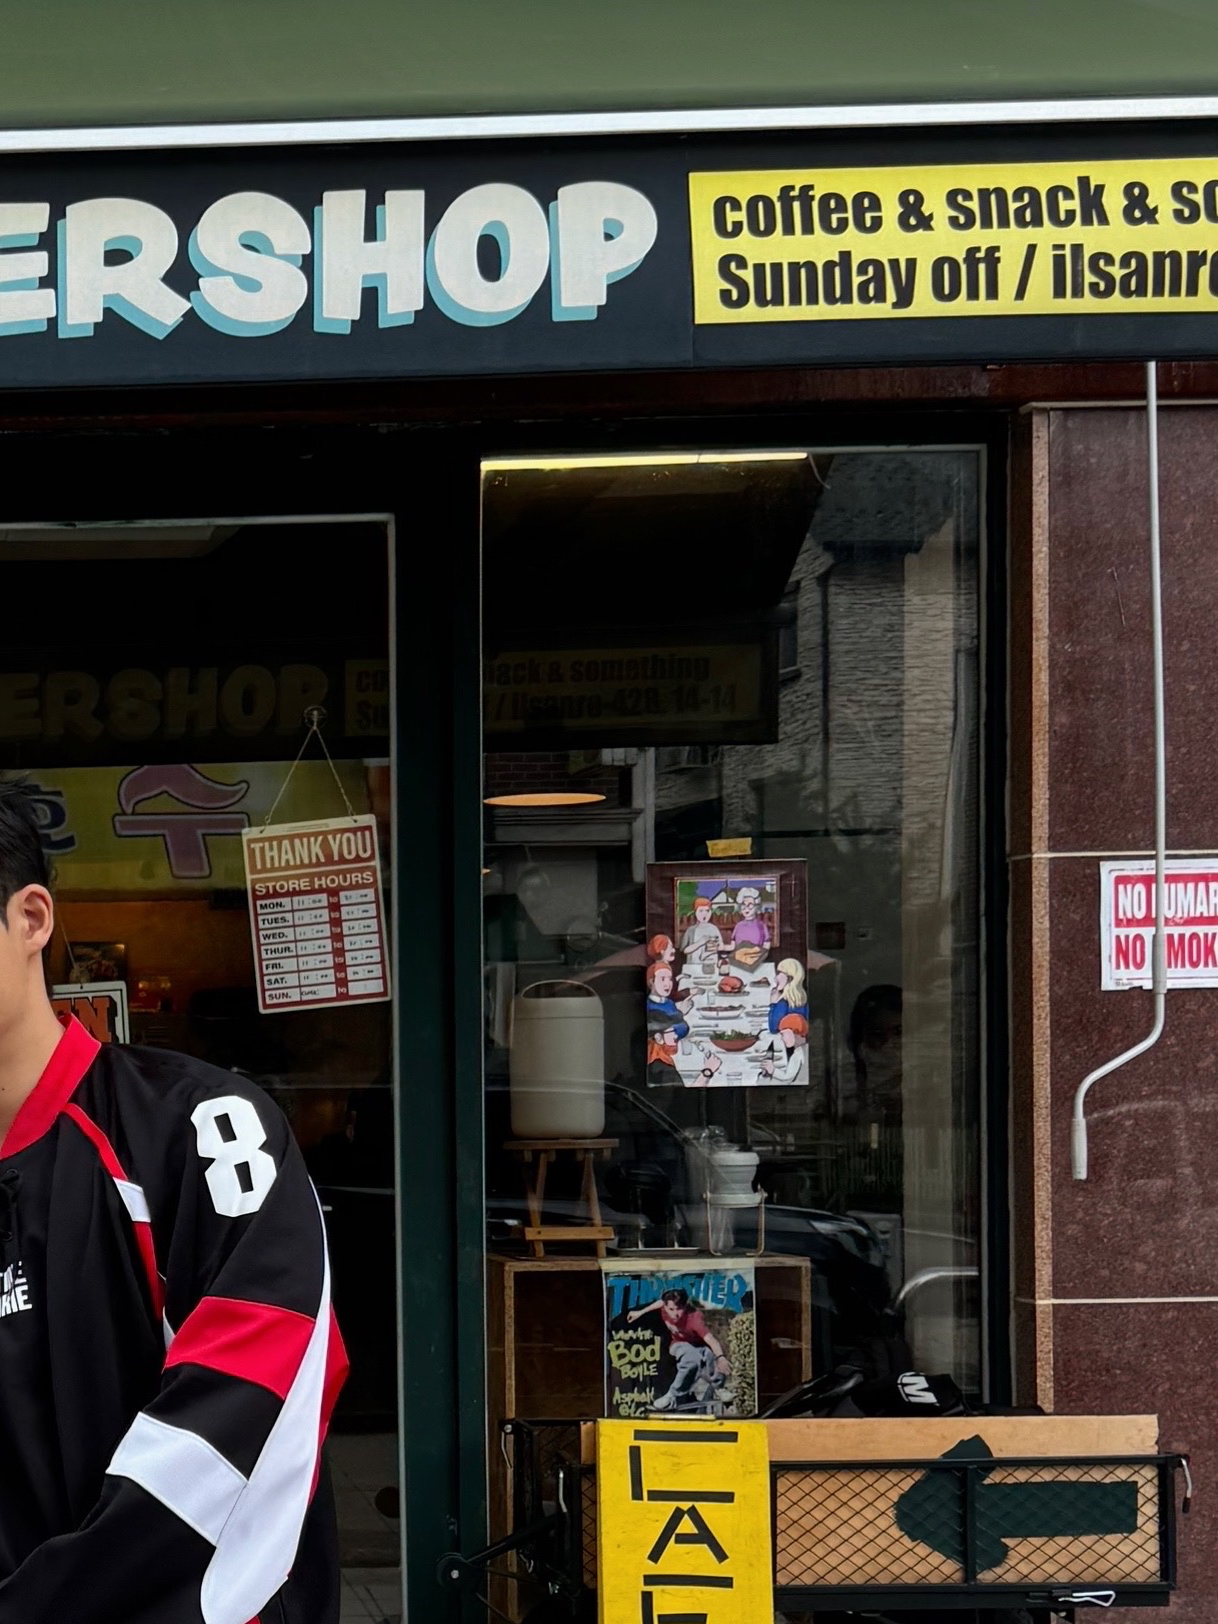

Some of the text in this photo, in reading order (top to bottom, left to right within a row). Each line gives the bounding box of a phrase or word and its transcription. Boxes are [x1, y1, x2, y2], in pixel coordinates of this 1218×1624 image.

[713, 184, 884, 239] coffee
[897, 188, 934, 232] &
[947, 176, 1110, 231] snack
[1122, 181, 1159, 226] &
[717, 250, 917, 309] Sunday
[931, 245, 1001, 302] off
[1014, 243, 1038, 301] /
[250, 829, 371, 870] THANK YOU
[254, 871, 374, 896] STORE HOURS
[259, 900, 286, 912] MON.
[1118, 883, 1146, 920] NO
[260, 915, 290, 926] TUES.
[261, 930, 288, 941] WED.
[263, 945, 294, 957] THUR.
[1115, 932, 1218, 970] NO MOK
[265, 961, 284, 971] FRI.
[266, 976, 287, 986] SAT.
[268, 991, 292, 1001] SUN.
[190, 1095, 277, 1218] 8
